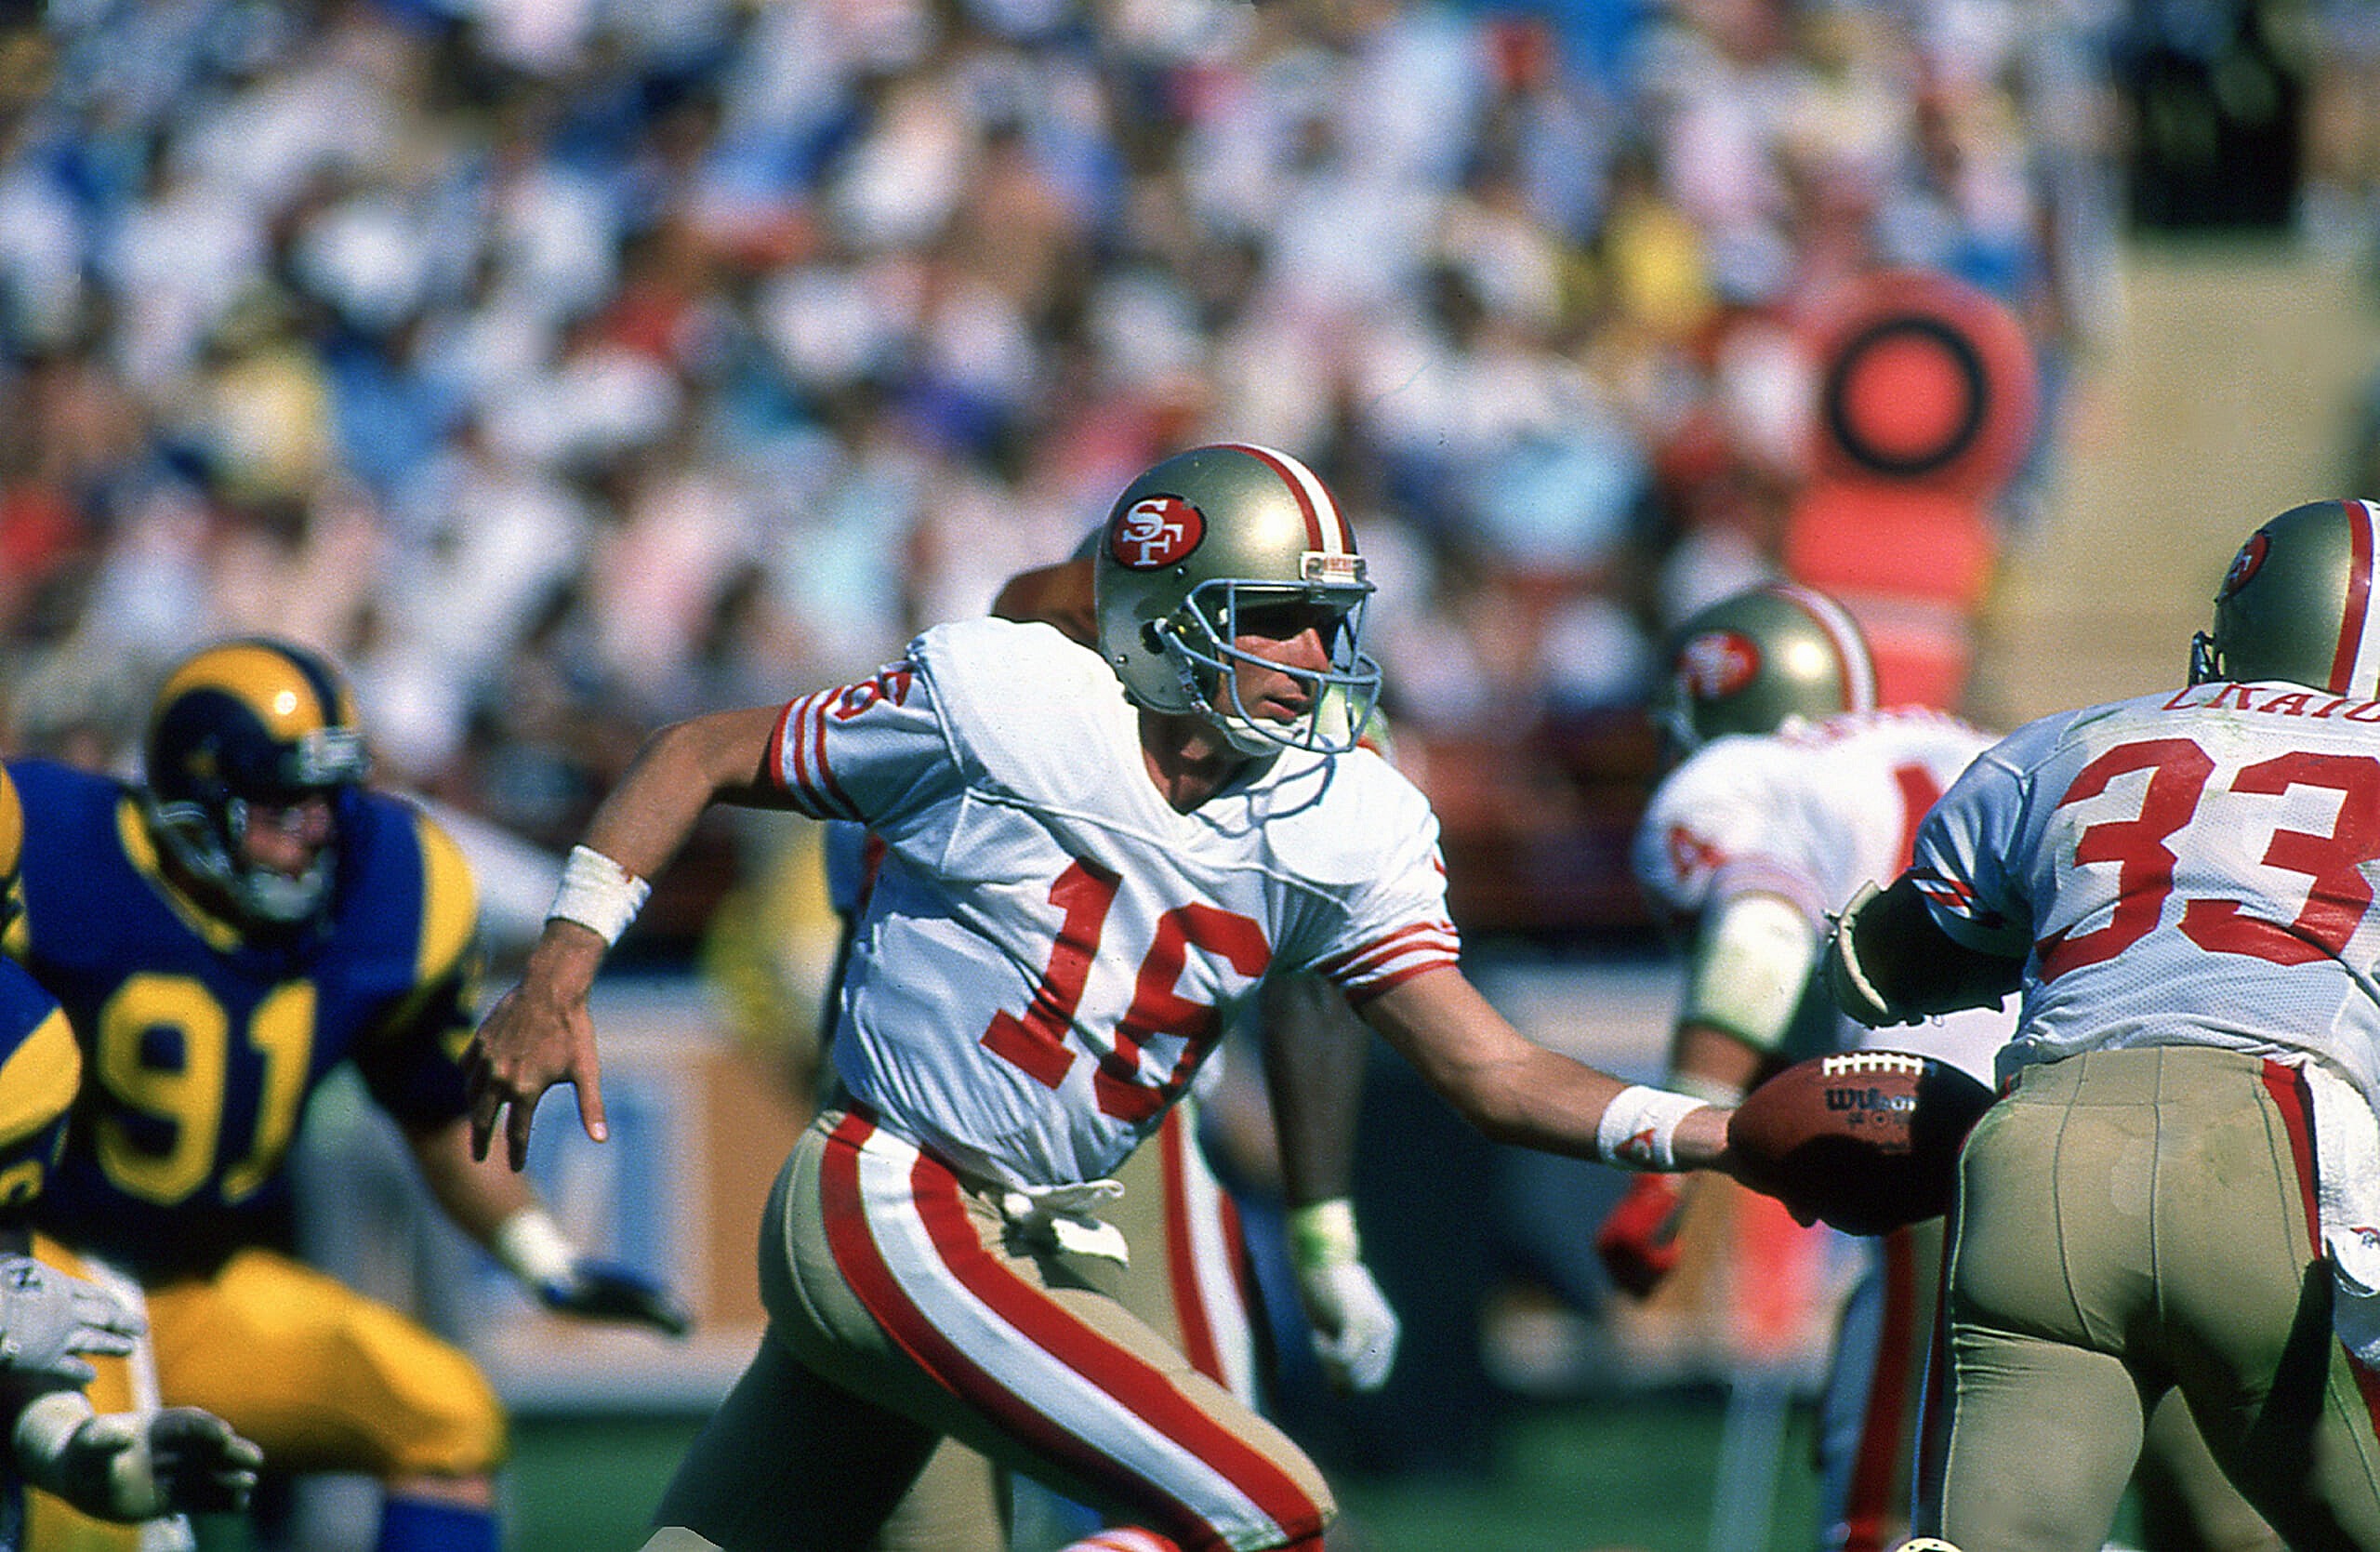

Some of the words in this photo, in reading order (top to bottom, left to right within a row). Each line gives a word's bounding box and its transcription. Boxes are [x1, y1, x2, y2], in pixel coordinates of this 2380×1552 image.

[1123, 499, 1183, 565] SF
[2036, 737, 2380, 985] 33
[96, 971, 319, 1207] 91
[981, 856, 1272, 1124] 16
